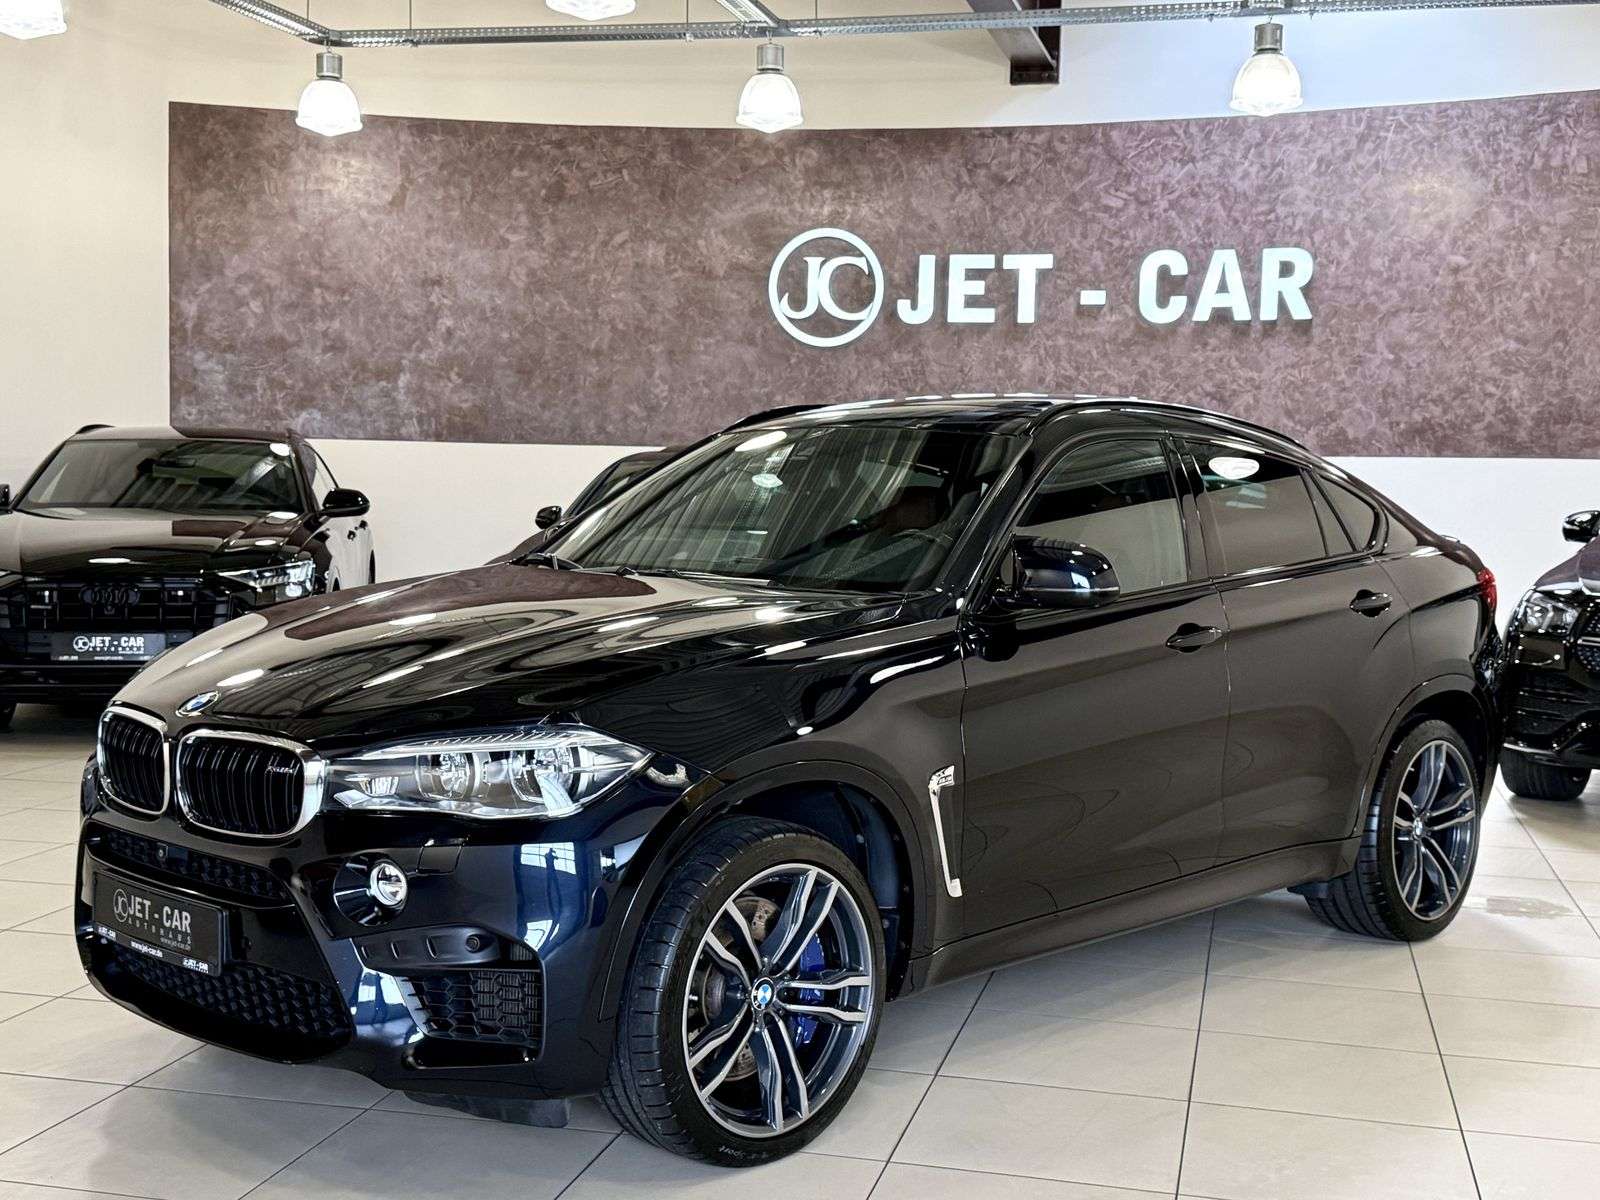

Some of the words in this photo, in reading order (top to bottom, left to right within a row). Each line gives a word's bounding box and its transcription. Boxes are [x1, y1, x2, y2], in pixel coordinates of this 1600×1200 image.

[897, 253, 1054, 325] JET
[1138, 247, 1315, 325] CAR
[89, 636, 111, 647] JET
[120, 636, 145, 647] CAR
[128, 894, 152, 920] JET
[162, 905, 192, 934] CAR
